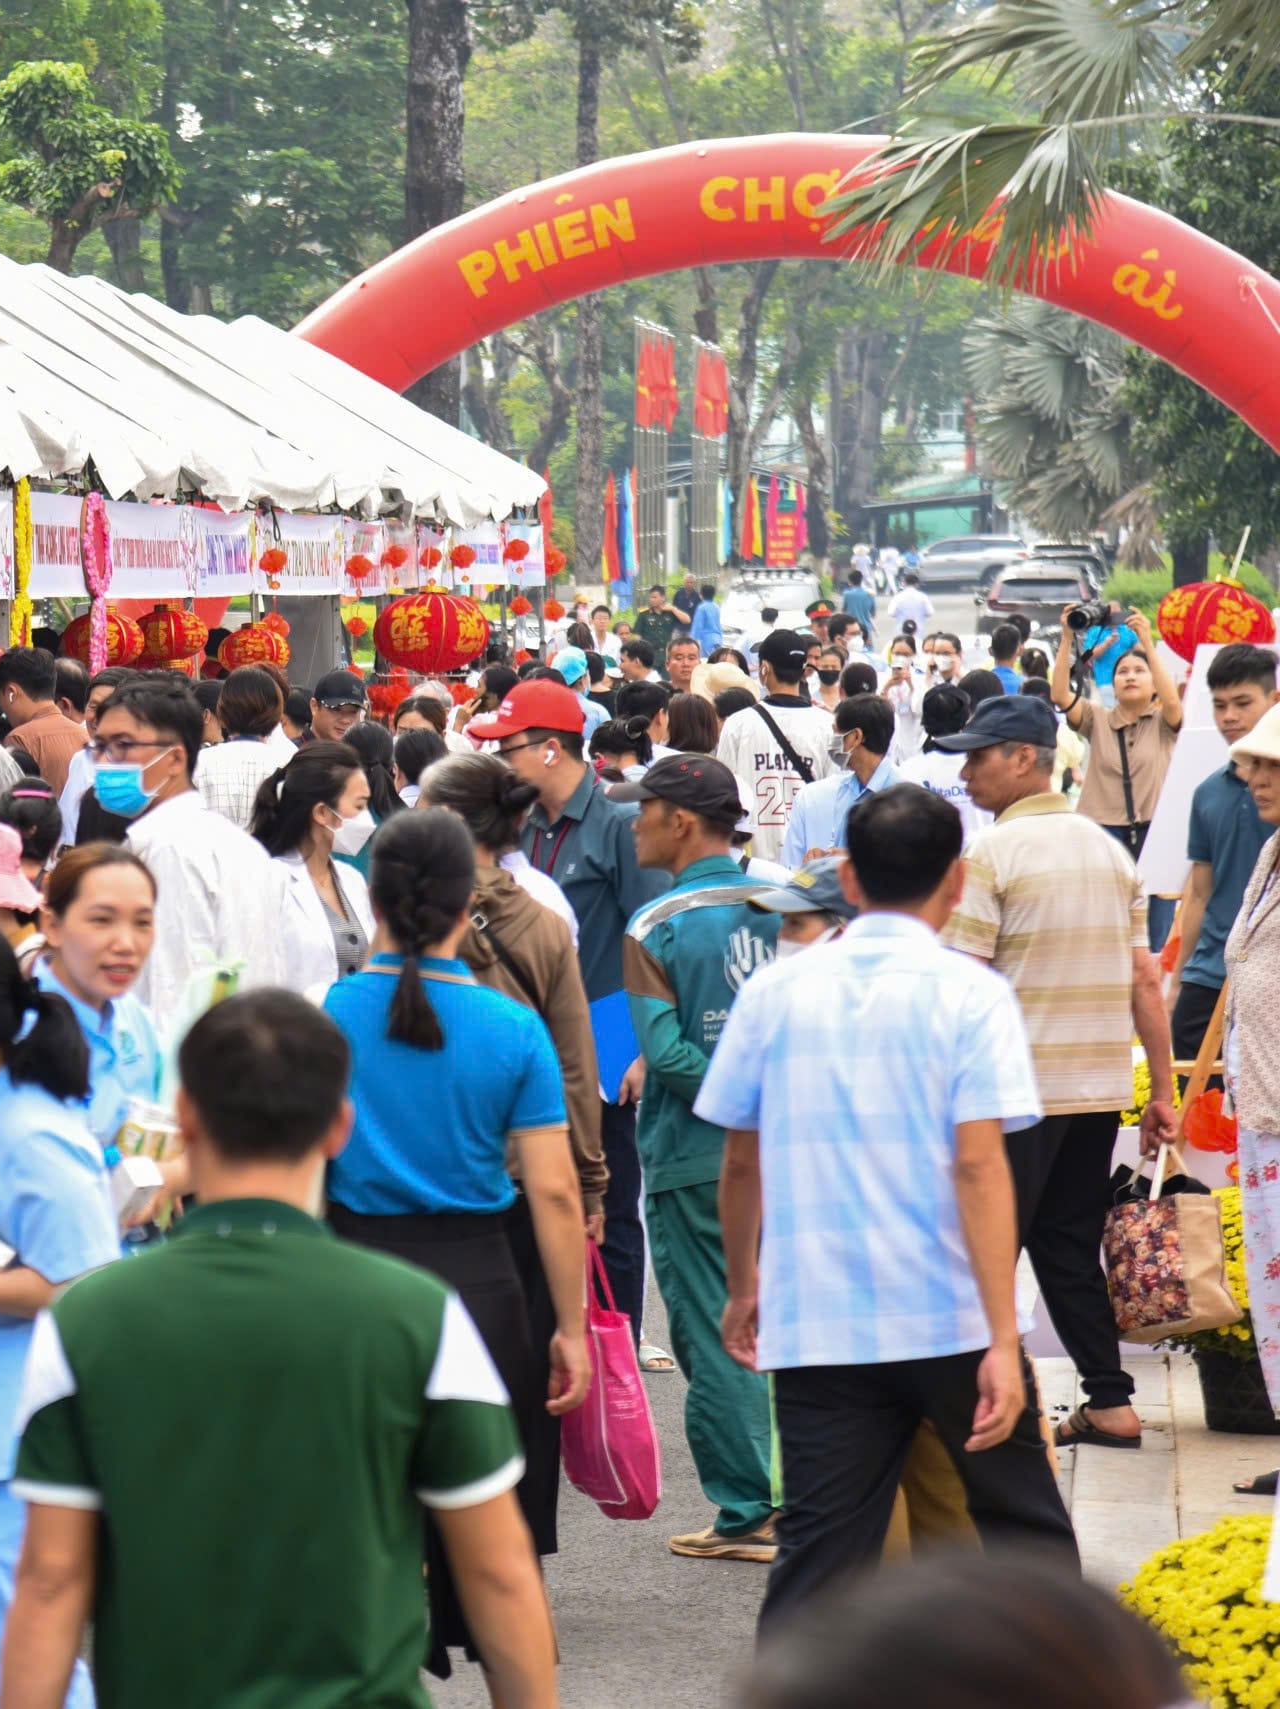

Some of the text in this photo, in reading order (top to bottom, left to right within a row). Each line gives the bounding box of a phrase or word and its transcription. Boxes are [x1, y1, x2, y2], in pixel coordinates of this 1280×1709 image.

[457, 193, 636, 298] PHIÊN
[700, 169, 841, 232] CHỢ
[754, 752, 813, 771] PLAYR
[703, 1009, 728, 1022] DA
